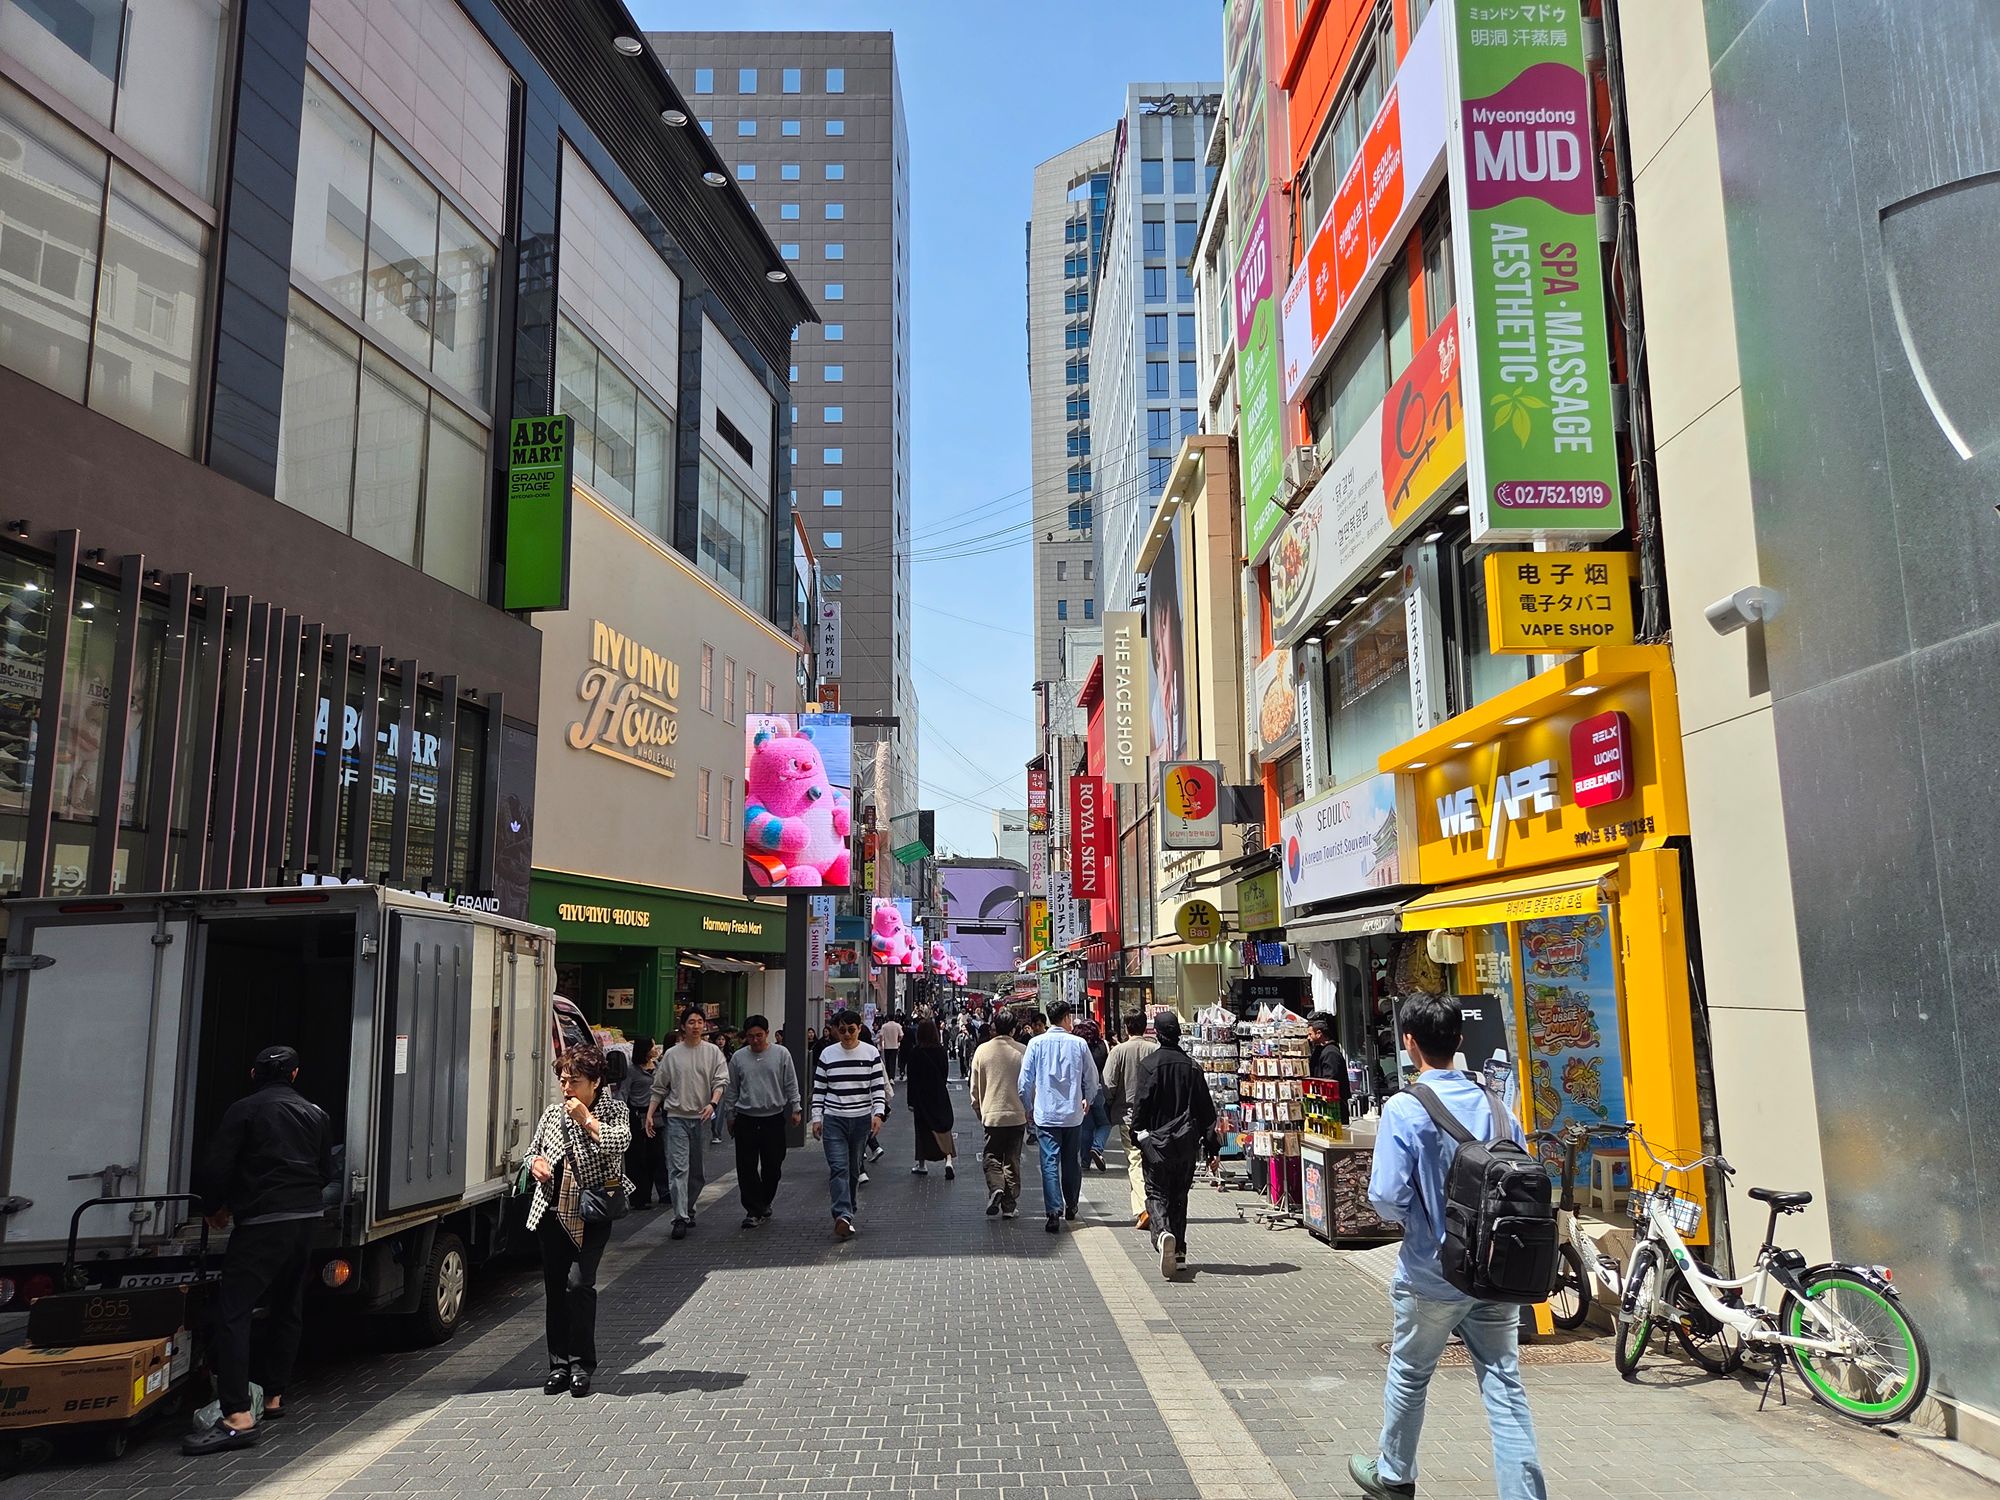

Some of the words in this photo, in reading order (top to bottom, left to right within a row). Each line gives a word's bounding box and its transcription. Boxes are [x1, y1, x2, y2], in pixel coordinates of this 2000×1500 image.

[1471, 29, 1507, 47] 明洞
[1513, 29, 1568, 47] 汗蒸房
[1146, 93, 1178, 117] Le
[1377, 90, 1397, 134] SOUVENIR
[1472, 108, 1576, 125] Myeongdong
[1373, 144, 1394, 188] SEOUL
[1474, 130, 1581, 182] MUD
[1369, 149, 1401, 214] SOUVENIR
[1340, 200, 1362, 253] 위베이프
[1241, 240, 1266, 325] MUD
[1540, 242, 1579, 296] SPA
[1490, 223, 1538, 383] AESTHETIC
[1244, 350, 1254, 384] SPA
[1287, 359, 1298, 388] YH
[1544, 310, 1593, 454] MASSAGE
[1248, 379, 1268, 436] MASSAGE
[512, 420, 564, 447] ABC
[512, 446, 563, 465] MART
[1250, 428, 1274, 487] AESTHETIC
[512, 471, 555, 484] GRAND
[512, 482, 550, 493] STAGE
[1515, 485, 1604, 504] 02.752.1919
[1518, 563, 1608, 586] 电子烟
[1519, 594, 1612, 613] 電子タバコ
[1115, 626, 1130, 662] THE
[1520, 624, 1564, 636] VAPE
[1570, 624, 1615, 636] SHOP
[0, 663, 44, 684] BC-MART
[1115, 664, 1132, 715] FACE
[566, 666, 678, 750] House
[1118, 715, 1134, 767] SHOP
[1592, 726, 1618, 744] RELX
[636, 746, 678, 771] WHOLESALE
[1080, 783, 1094, 845] ROYAL
[1317, 802, 1342, 832] SEOUL
[1304, 849, 1322, 866] Korean
[1323, 843, 1343, 860] Tourist
[1344, 831, 1372, 853] Souvenir
[1081, 846, 1096, 892] SKIN
[455, 894, 500, 912] GRAND
[558, 903, 612, 924] NYUNYU
[612, 908, 650, 928] HOUSE
[1188, 904, 1210, 926] 光
[703, 916, 732, 936] Harmony
[732, 919, 749, 934] Fresh
[748, 922, 762, 935] Mart
[1190, 927, 1210, 939] Bag
[811, 928, 819, 967] SHINING
[84, 1297, 130, 1318] 1855
[64, 1395, 118, 1412] BEEF
